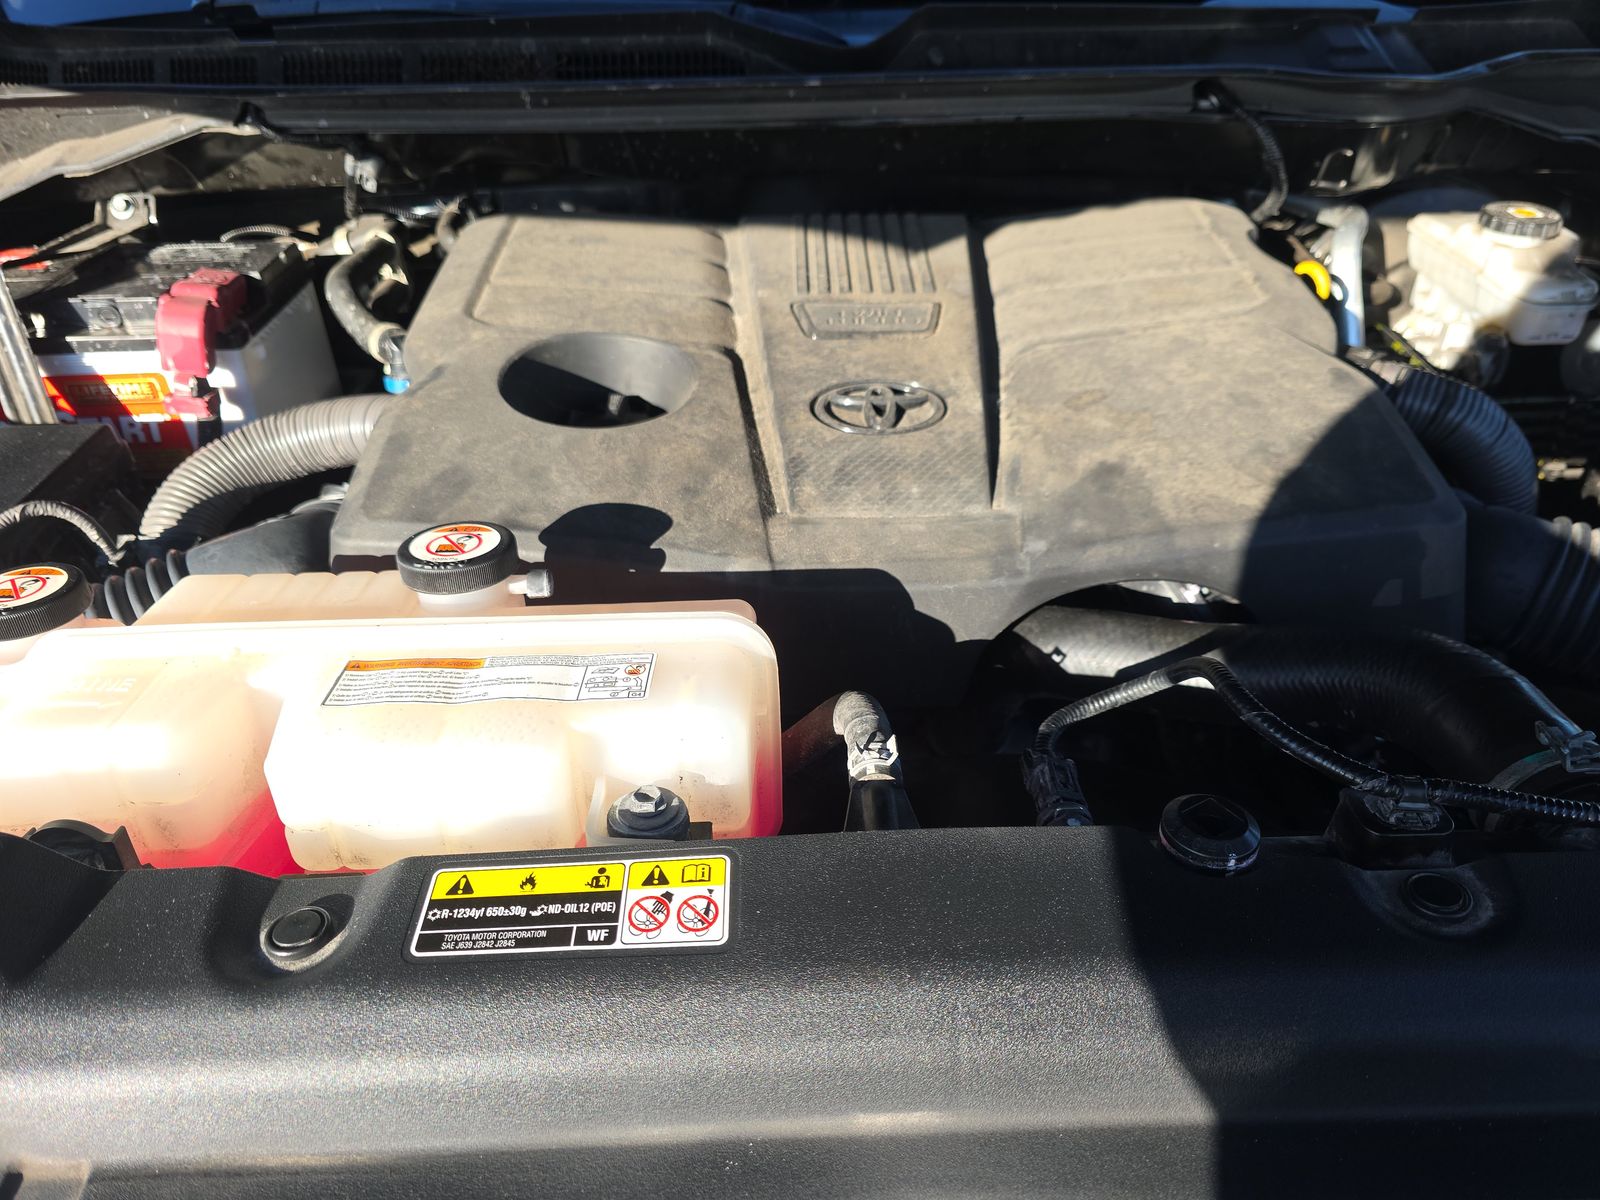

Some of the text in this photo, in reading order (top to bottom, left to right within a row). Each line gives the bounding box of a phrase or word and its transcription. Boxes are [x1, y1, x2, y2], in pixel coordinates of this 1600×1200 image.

[441, 902, 616, 920] R-1234yf 650±30g ND-OIL12 (POE)
[444, 930, 547, 942] TOYOTA MOTOR CORPORATION
[587, 929, 610, 942] WF
[441, 940, 516, 950] SAE J639 J2842 J2845
